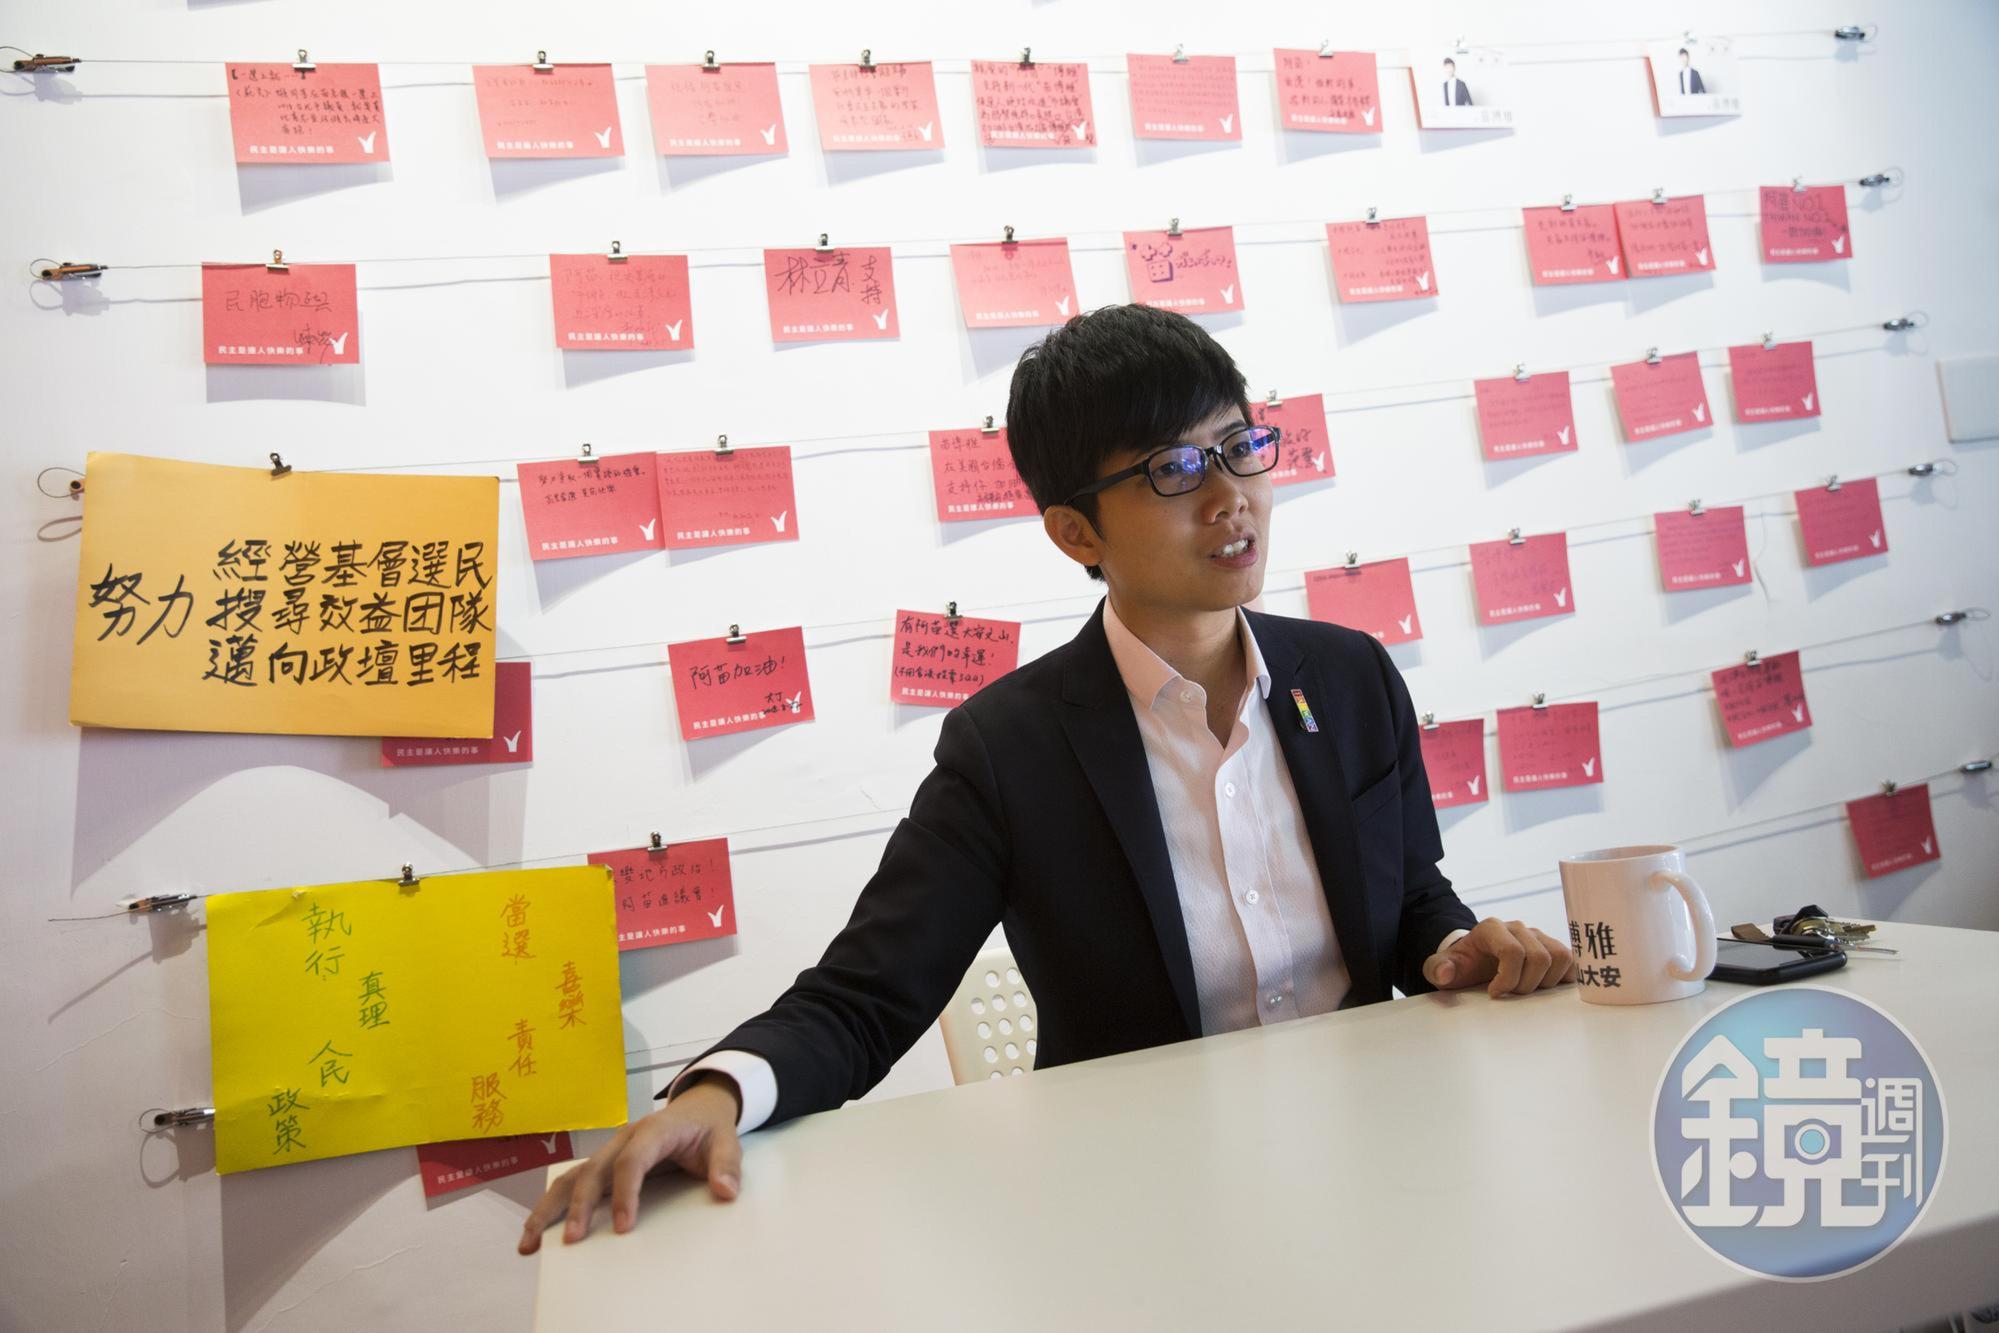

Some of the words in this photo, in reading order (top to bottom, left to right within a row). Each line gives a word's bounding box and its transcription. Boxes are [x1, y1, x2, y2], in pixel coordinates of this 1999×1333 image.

[212, 538, 493, 591] 經營基層選民
[88, 563, 195, 646] 努力
[201, 633, 484, 688] 邁向政壇里程
[357, 971, 391, 1031] 真理
[507, 1017, 537, 1079] 責任
[267, 1087, 311, 1155] 政策
[470, 1071, 508, 1136] 服務
